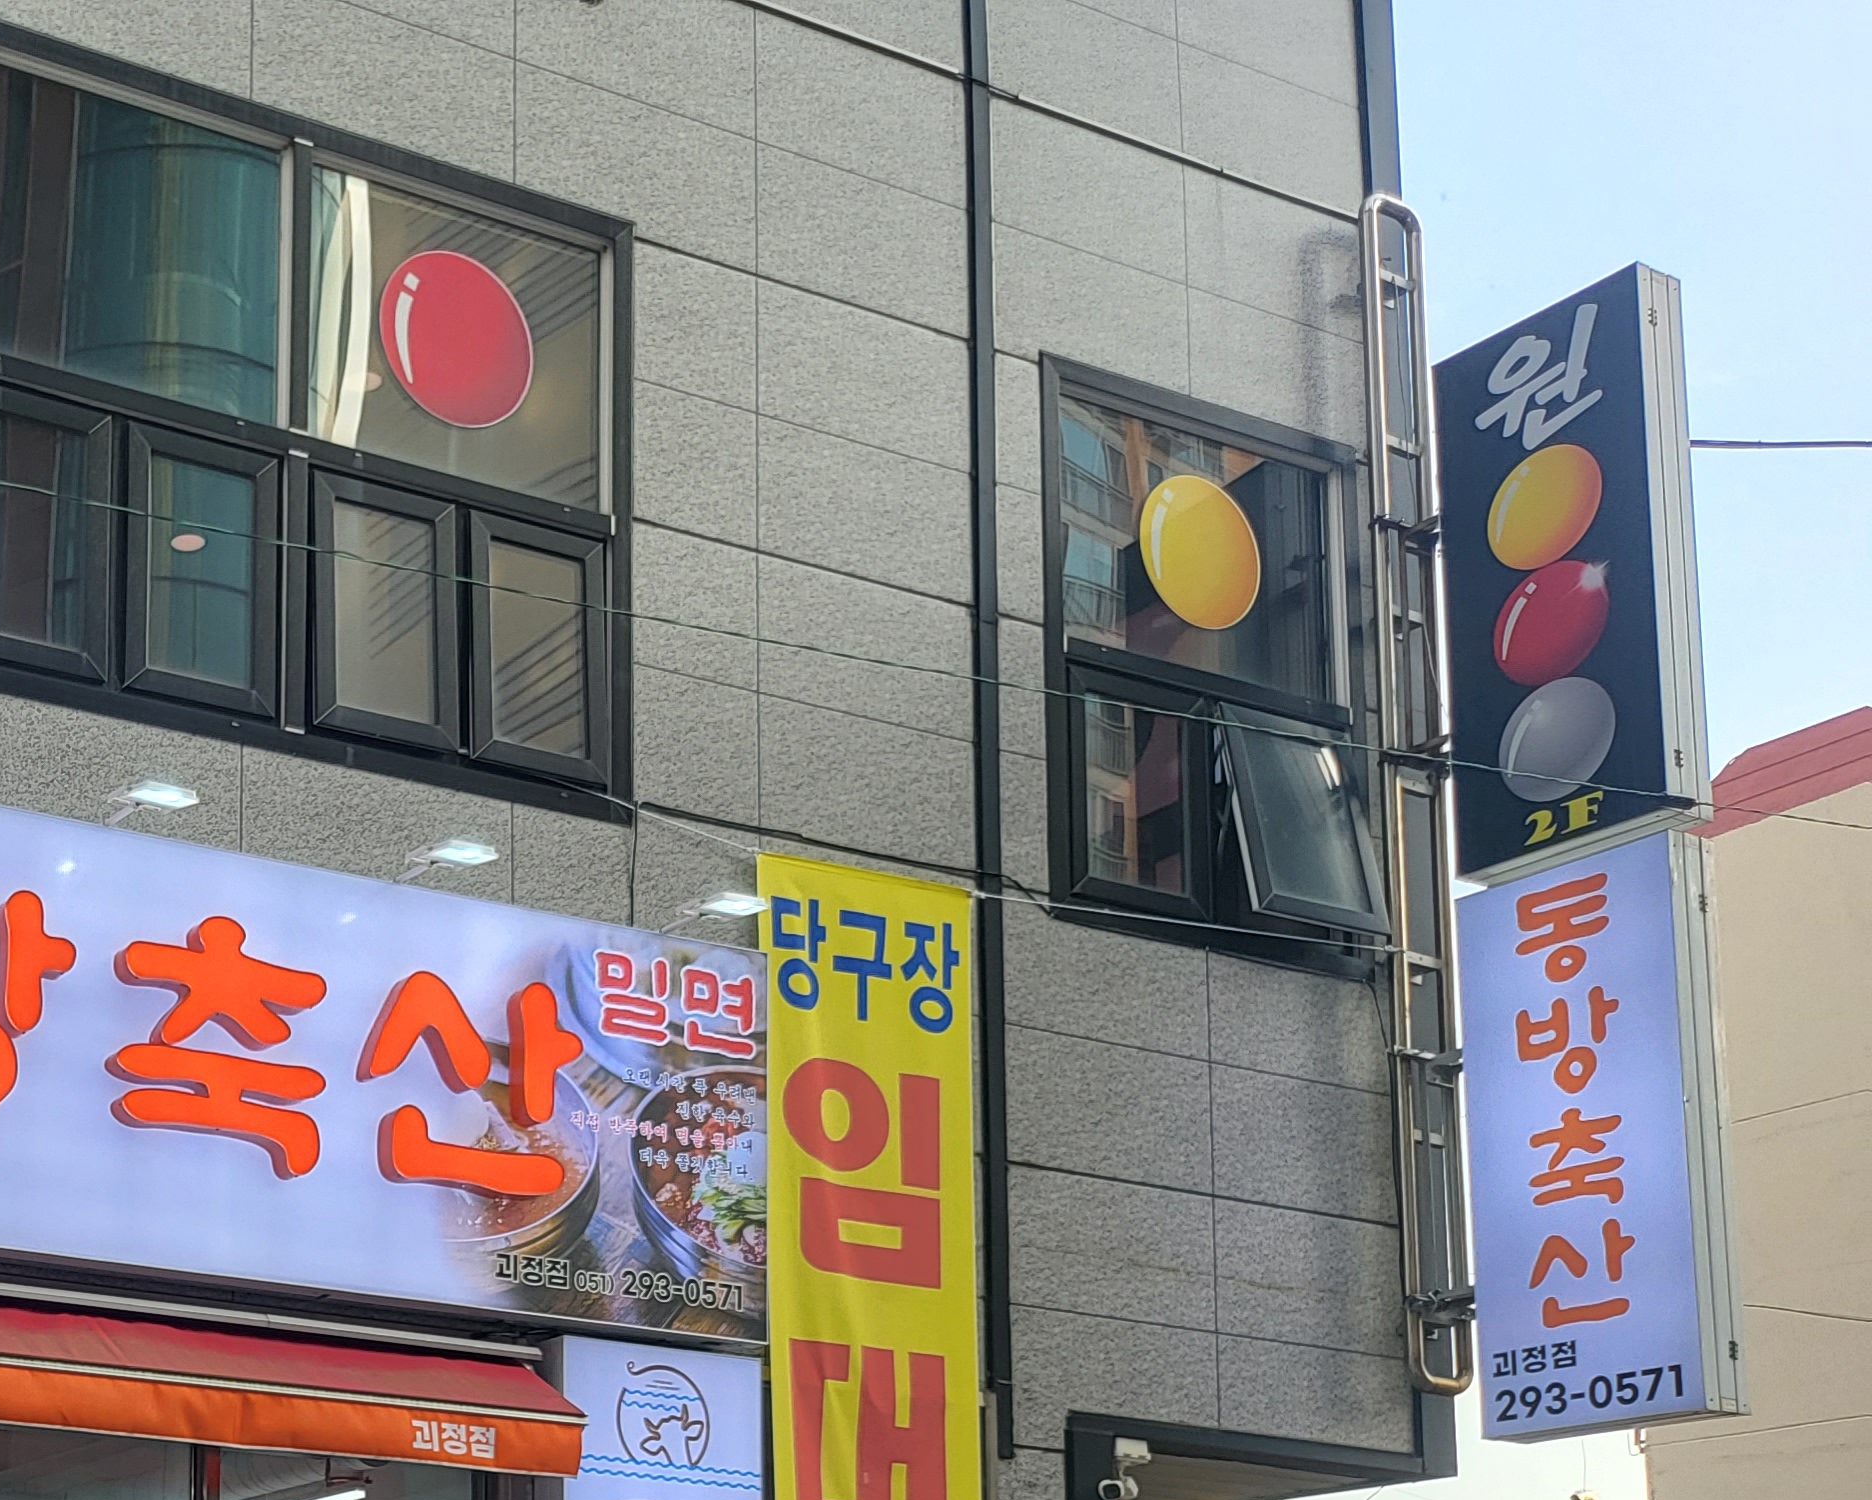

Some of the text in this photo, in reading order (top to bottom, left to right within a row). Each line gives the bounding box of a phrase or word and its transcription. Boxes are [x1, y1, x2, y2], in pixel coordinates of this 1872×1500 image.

[1472, 302, 1605, 455] 원
[1522, 790, 1605, 850] 2F
[769, 893, 961, 1034] 당구장
[594, 951, 756, 1060] 밀면
[623, 1068, 757, 1104] 오랜 시간 푹 우려낸
[1513, 871, 1637, 1332] 동방축산
[571, 1111, 600, 1131] 직접
[609, 1118, 668, 1143] 반죽하여
[675, 1127, 705, 1147] 면을
[676, 1102, 756, 1131] 진한 육수와
[639, 1147, 670, 1168] 더욱
[495, 1253, 744, 1311] 괴정점 051) 293-0571
[1492, 1338, 1580, 1382] 괴정점
[1494, 1363, 1686, 1425] 293-0571
[411, 1419, 496, 1460] 괴정점
